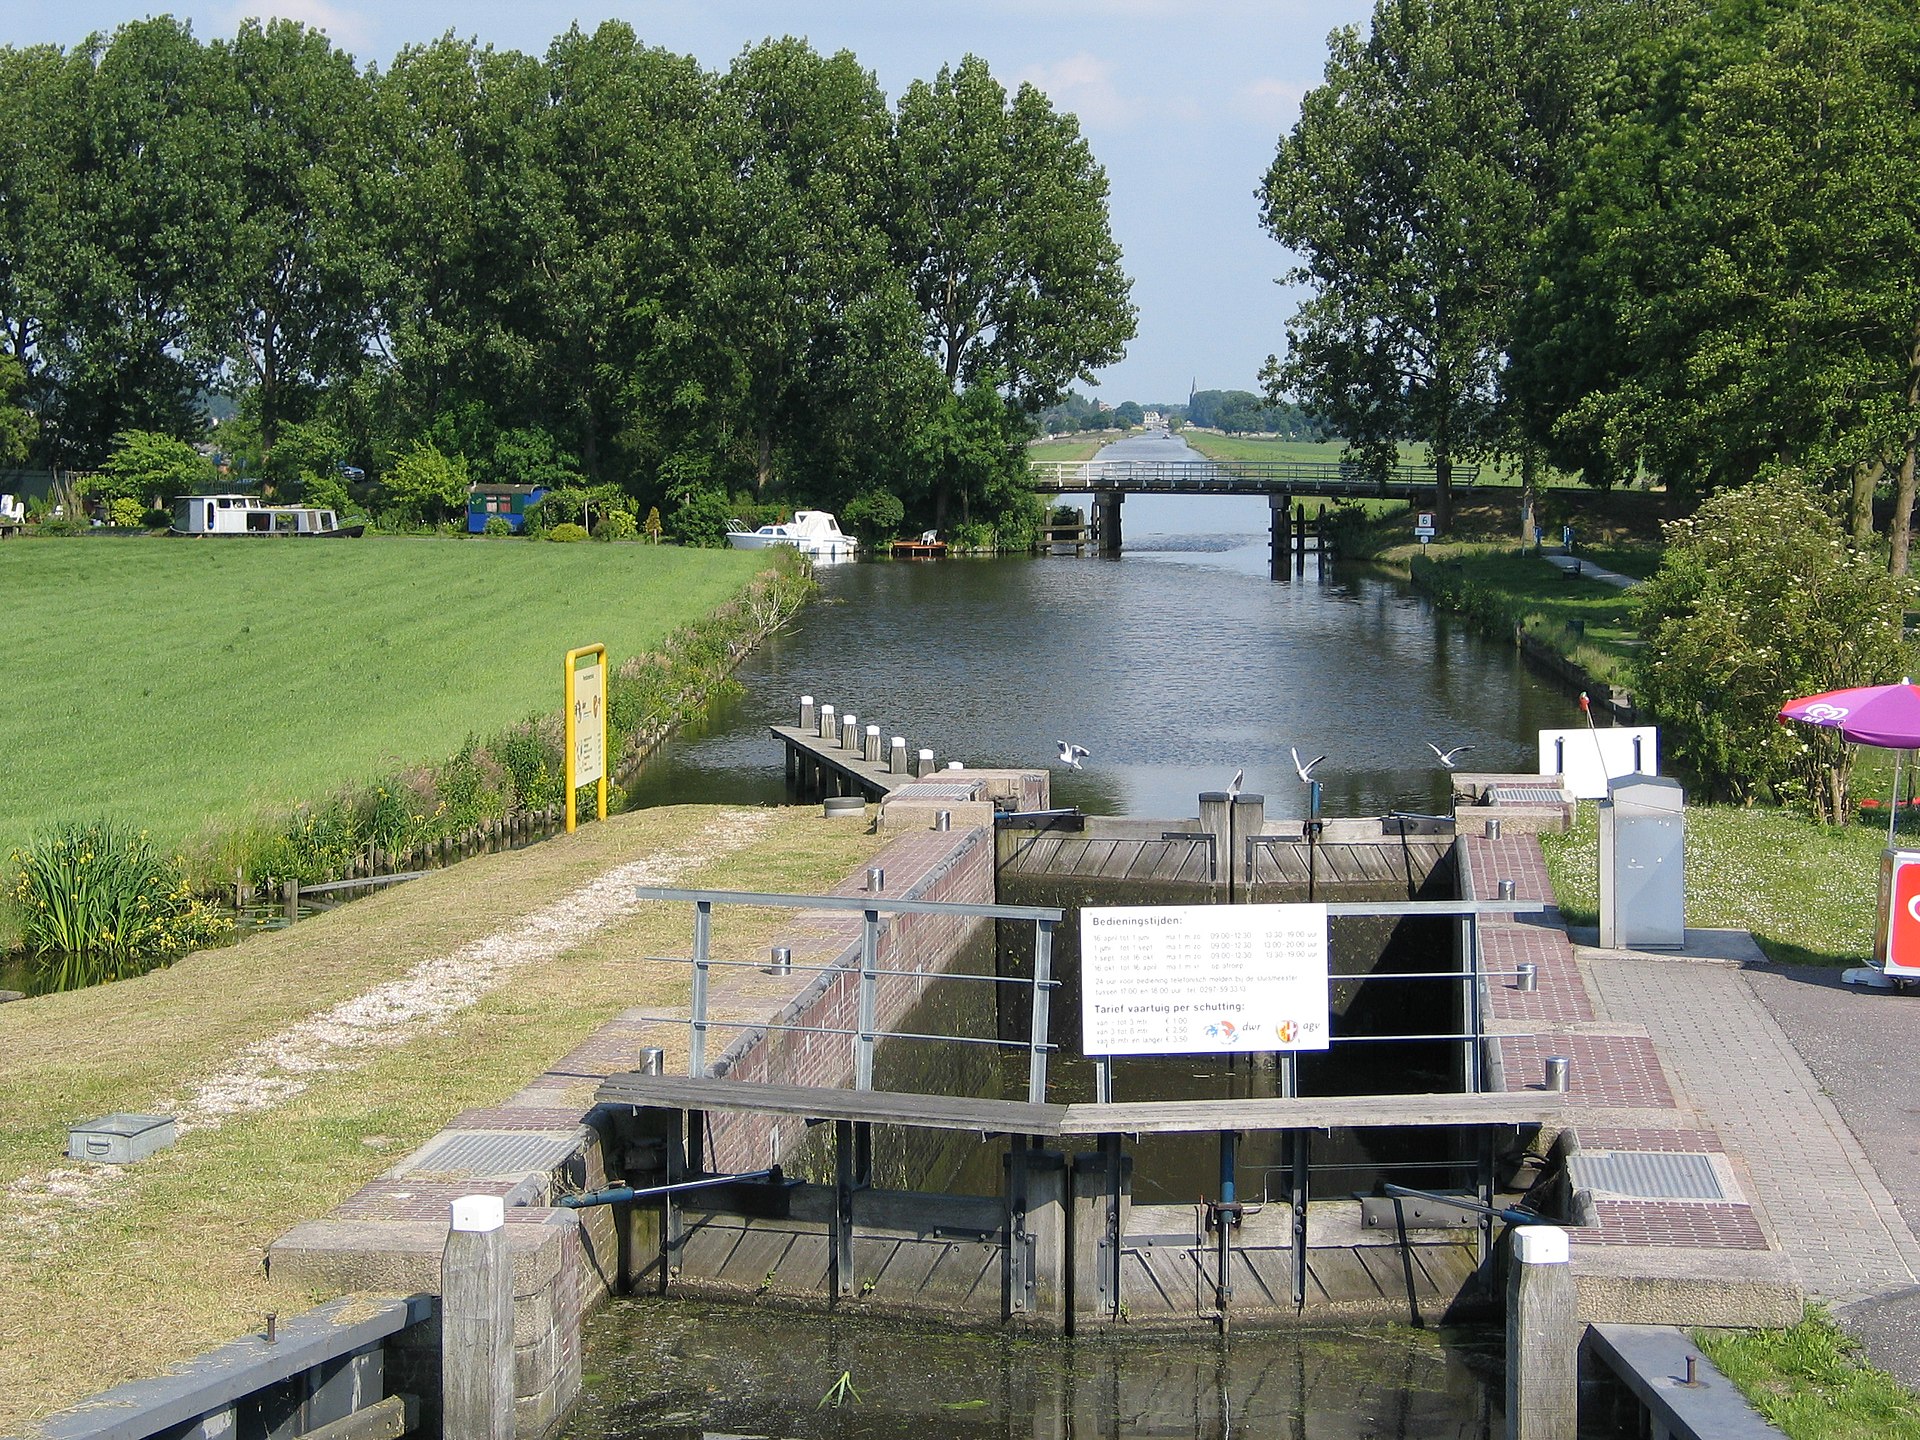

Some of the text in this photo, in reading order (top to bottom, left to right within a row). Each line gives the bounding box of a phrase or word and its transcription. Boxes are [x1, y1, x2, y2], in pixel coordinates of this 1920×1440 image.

[1422, 516, 1428, 525] 6
[1092, 916, 1183, 927] Bedieningstijden:
[1095, 1002, 1245, 1014] Tarief vaartuig per schutting:
[1242, 1022, 1262, 1031] dwr
[1302, 1022, 1320, 1032] agv
